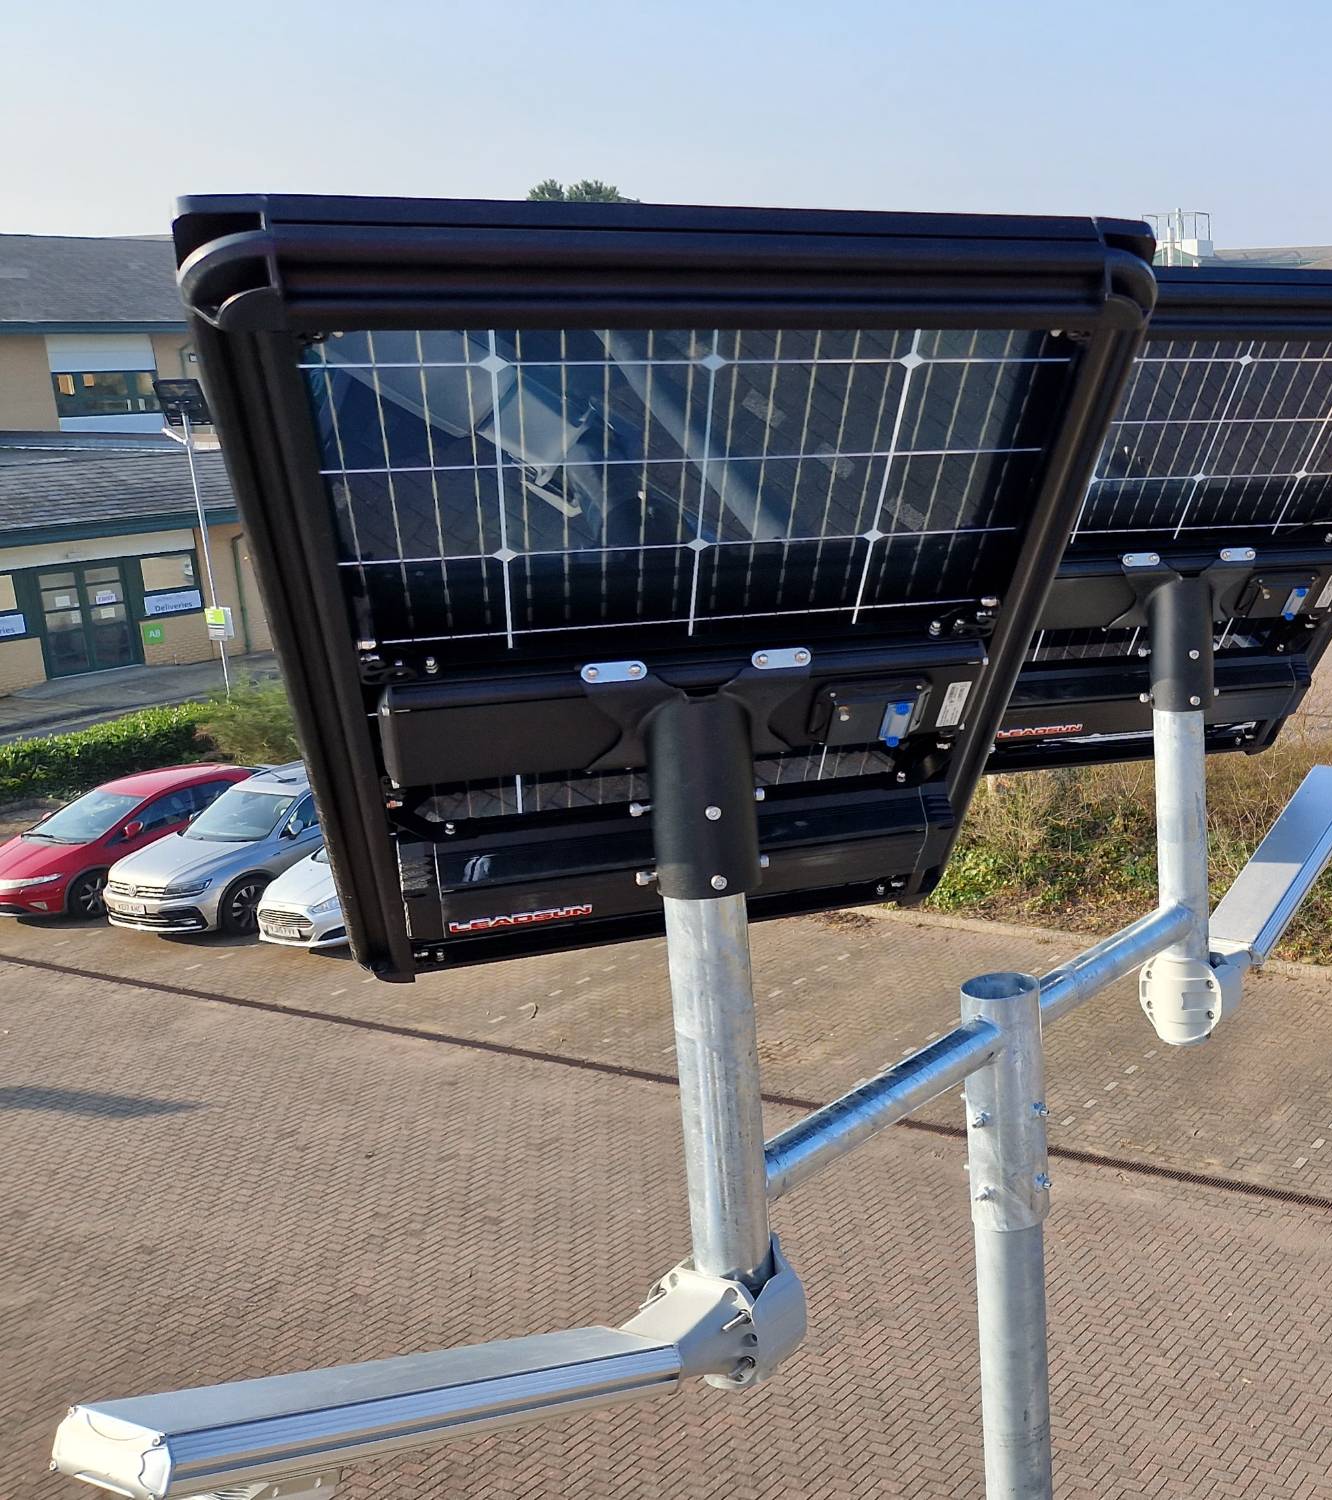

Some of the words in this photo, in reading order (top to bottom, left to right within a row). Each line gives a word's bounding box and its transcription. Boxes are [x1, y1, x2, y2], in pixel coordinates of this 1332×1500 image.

[154, 601, 193, 612] Deliveries
[996, 724, 1083, 739] LEADSUN
[449, 904, 593, 933] LEADSUN
